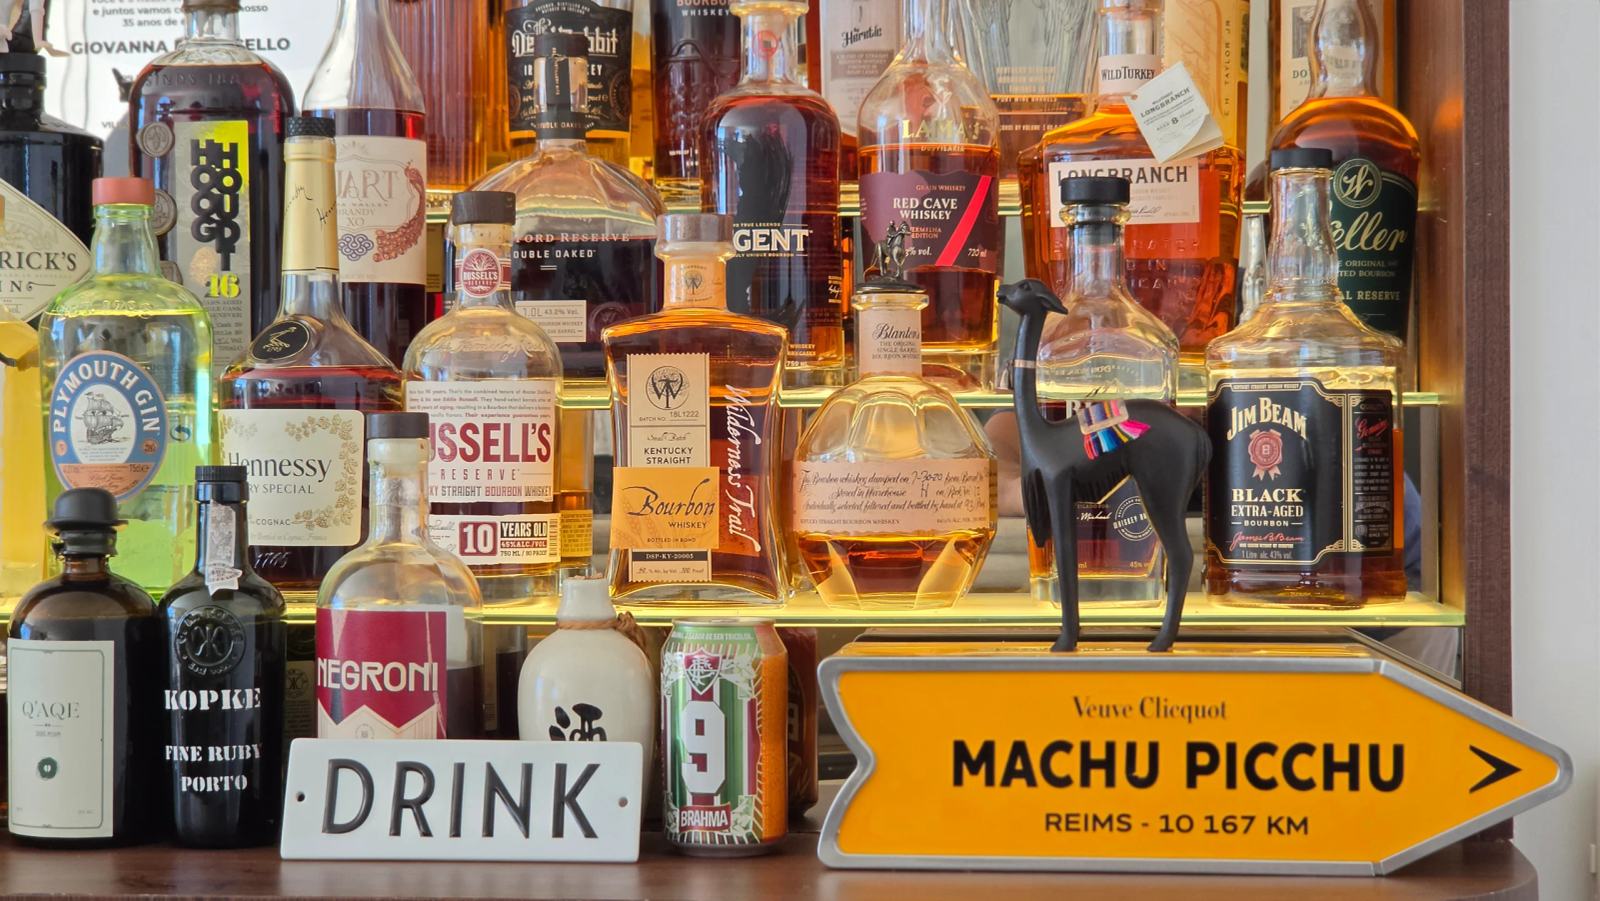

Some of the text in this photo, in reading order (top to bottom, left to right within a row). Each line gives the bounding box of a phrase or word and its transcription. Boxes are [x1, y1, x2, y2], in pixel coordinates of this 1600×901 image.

[101, 7, 134, 16] juntos
[123, 19, 134, 27] 35
[165, 18, 178, 26] de
[841, 25, 882, 48] Heretic
[71, 40, 168, 54] GIOVANNA
[1102, 66, 1155, 80] WILD TURKEY
[1140, 87, 1190, 118] LONGBRANCH
[893, 198, 958, 210] RED CAVE
[347, 217, 365, 226] XO
[900, 210, 952, 220] WHISKEY
[560, 232, 630, 242] RESERVE
[732, 229, 810, 252] GENT
[513, 250, 594, 259] OUBLE OAKED
[464, 272, 498, 280] RUSSELL'S
[205, 273, 241, 298] 16
[1358, 291, 1400, 300] RESERVE
[53, 360, 140, 433] PLYMOUTH
[134, 389, 160, 432] GIN
[1227, 397, 1308, 440] JIM BEAM
[644, 447, 693, 455] KENTUCKY
[229, 452, 332, 482] Hennessy
[646, 456, 692, 464] STRAIGHT
[440, 468, 518, 480] RESERVE
[263, 484, 314, 494] SPECIAL
[441, 486, 482, 497] STRAIGHT
[484, 486, 522, 496] BOURBON
[1232, 488, 1304, 502] BLACK
[622, 478, 716, 518] Bourbon
[1231, 504, 1304, 517] EXTRA-AGED
[256, 518, 291, 526] COGNAC
[502, 521, 548, 538] YEARS OLD
[463, 524, 494, 554] 10
[317, 658, 438, 692] NEGRONI
[164, 688, 260, 710] KOPKE
[1074, 696, 1226, 724] Veuve Clicquot
[165, 744, 262, 762] FINE RUBY
[681, 700, 726, 794] 9
[954, 740, 1405, 792] MACHU PICCHU
[181, 774, 248, 792] PORTO
[322, 758, 600, 839] DRINK
[680, 810, 728, 828] BRAHMA
[1046, 812, 1132, 832] REIMS
[1160, 814, 1194, 834] 10
[1204, 814, 1256, 834] 167
[1268, 816, 1308, 836] KM
